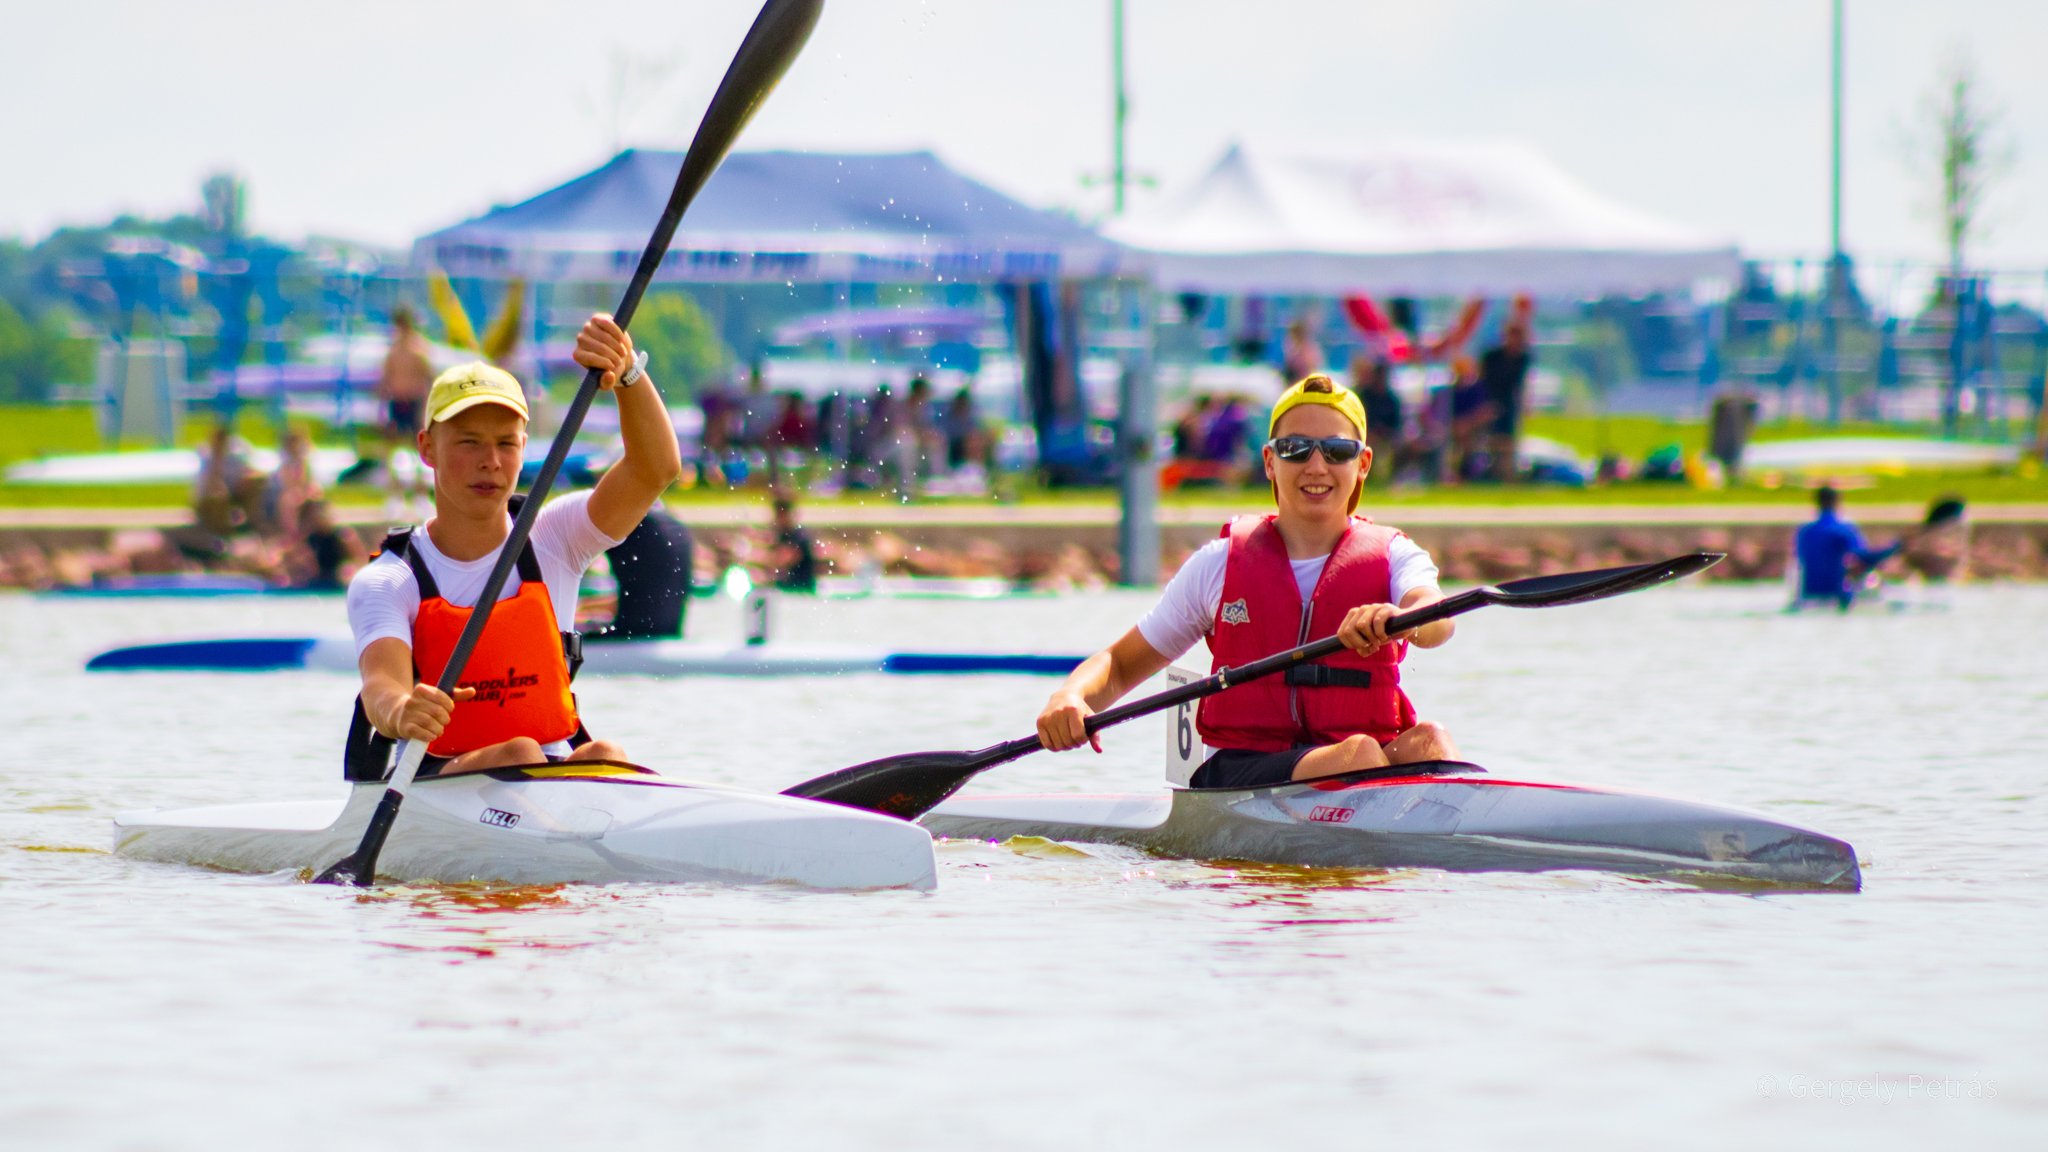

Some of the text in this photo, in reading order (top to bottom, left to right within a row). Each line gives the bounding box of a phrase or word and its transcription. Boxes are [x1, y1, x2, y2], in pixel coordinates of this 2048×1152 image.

[1178, 700, 1192, 761] 6
[480, 808, 520, 829] NELO
[1309, 806, 1354, 823] NELO
